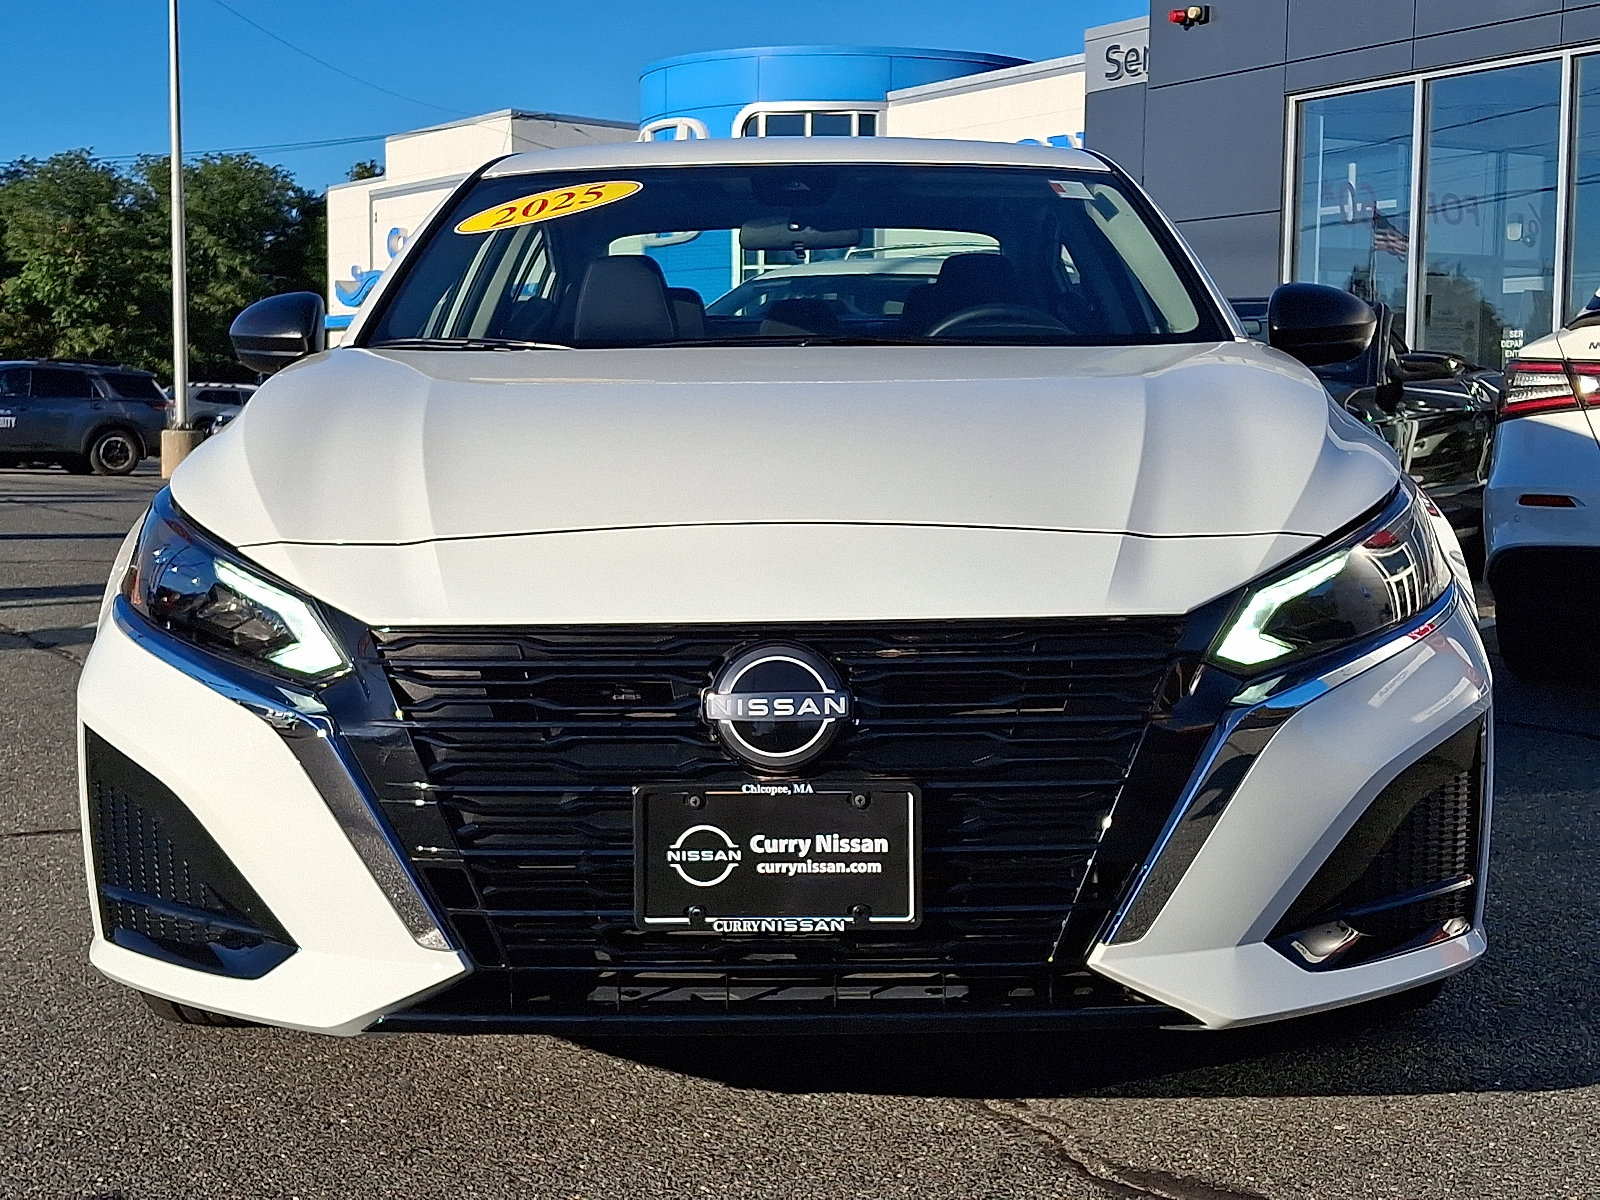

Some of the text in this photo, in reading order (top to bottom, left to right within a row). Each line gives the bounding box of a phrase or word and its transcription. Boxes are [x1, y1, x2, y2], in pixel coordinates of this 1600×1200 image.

[490, 184, 607, 228] 2025
[711, 697, 846, 717] NISSAN
[741, 783, 814, 796] Chicopee, MA
[750, 833, 890, 857] Curry Nissan
[666, 850, 742, 862] NISSAN
[756, 859, 883, 877] currynissan.com
